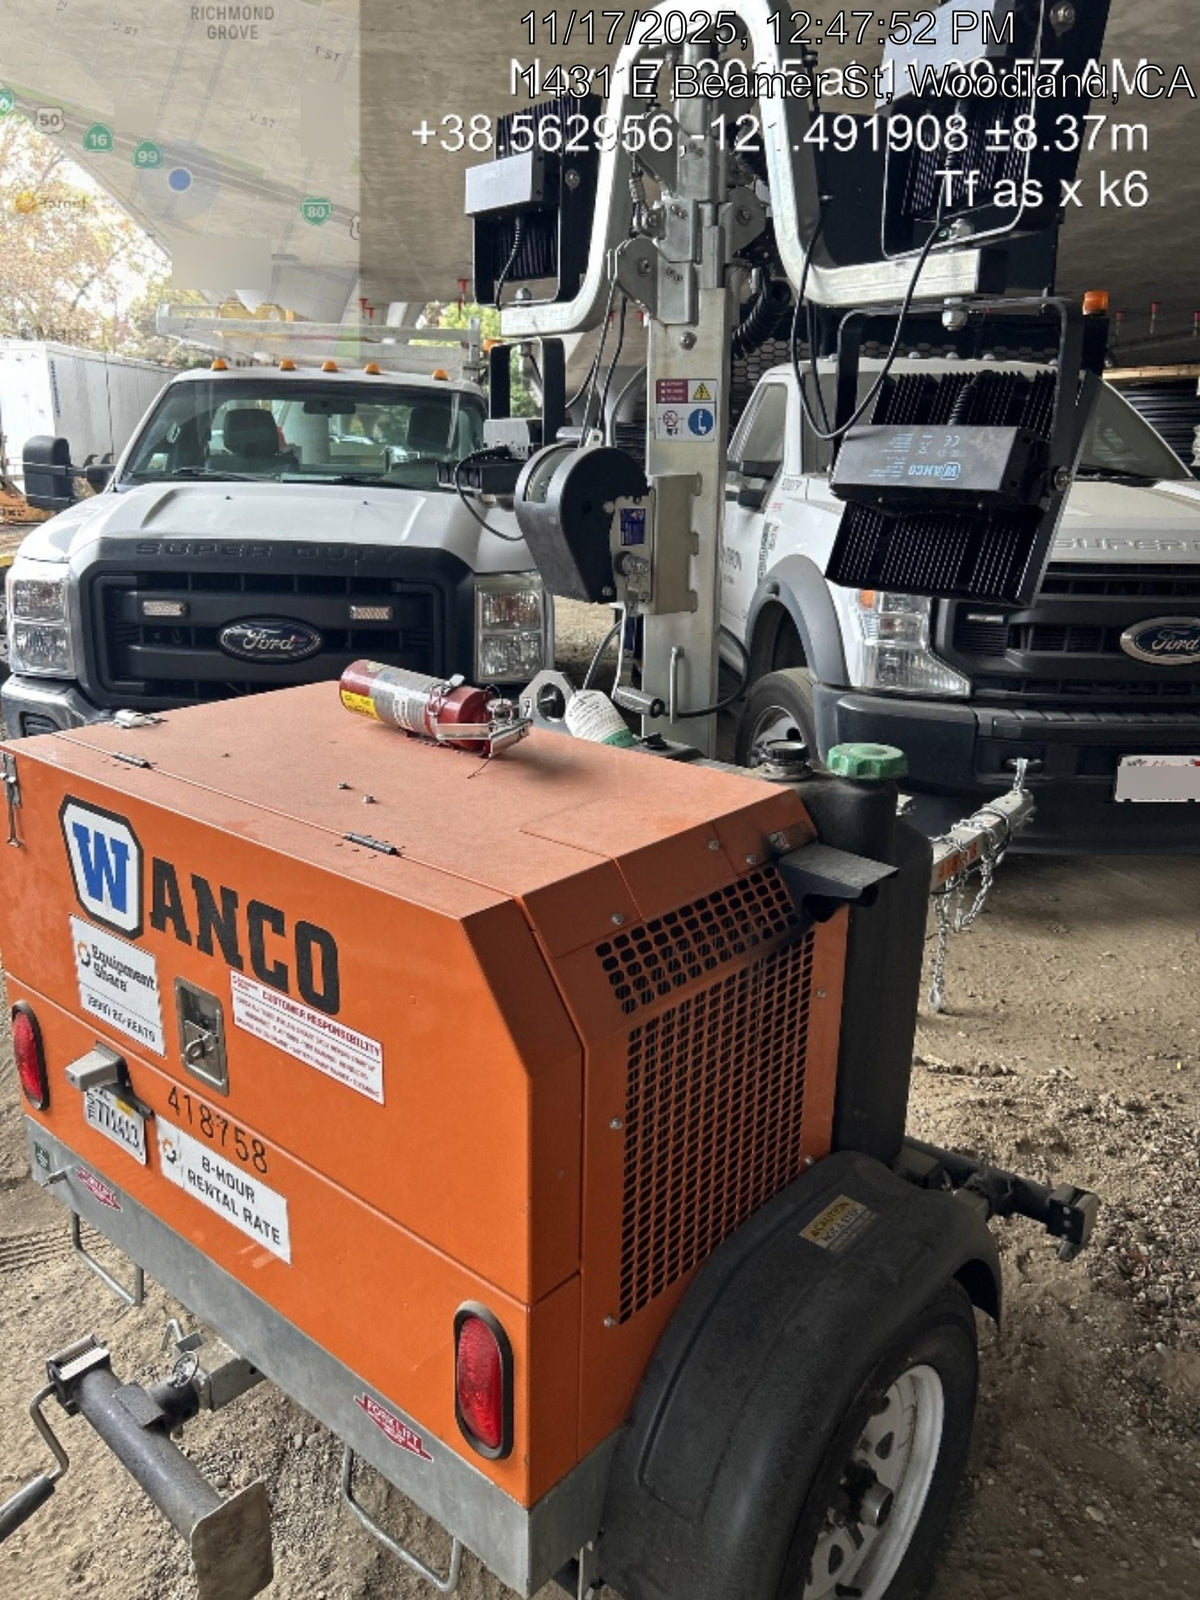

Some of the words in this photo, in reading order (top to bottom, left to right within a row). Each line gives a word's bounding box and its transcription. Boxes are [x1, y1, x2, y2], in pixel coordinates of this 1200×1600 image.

[136, 543, 273, 558] SUPER
[242, 628, 296, 651] Ford
[1150, 629, 1200, 652] Ford
[70, 820, 341, 1016] WANCO
[91, 943, 156, 991] Equipment
[262, 990, 306, 1020] CUSTOMER
[306, 1012, 380, 1057] RESPONSIBILITY
[168, 1085, 268, 1175] 418758
[187, 1169, 238, 1217] RENTAL
[242, 1208, 281, 1246] RATE
